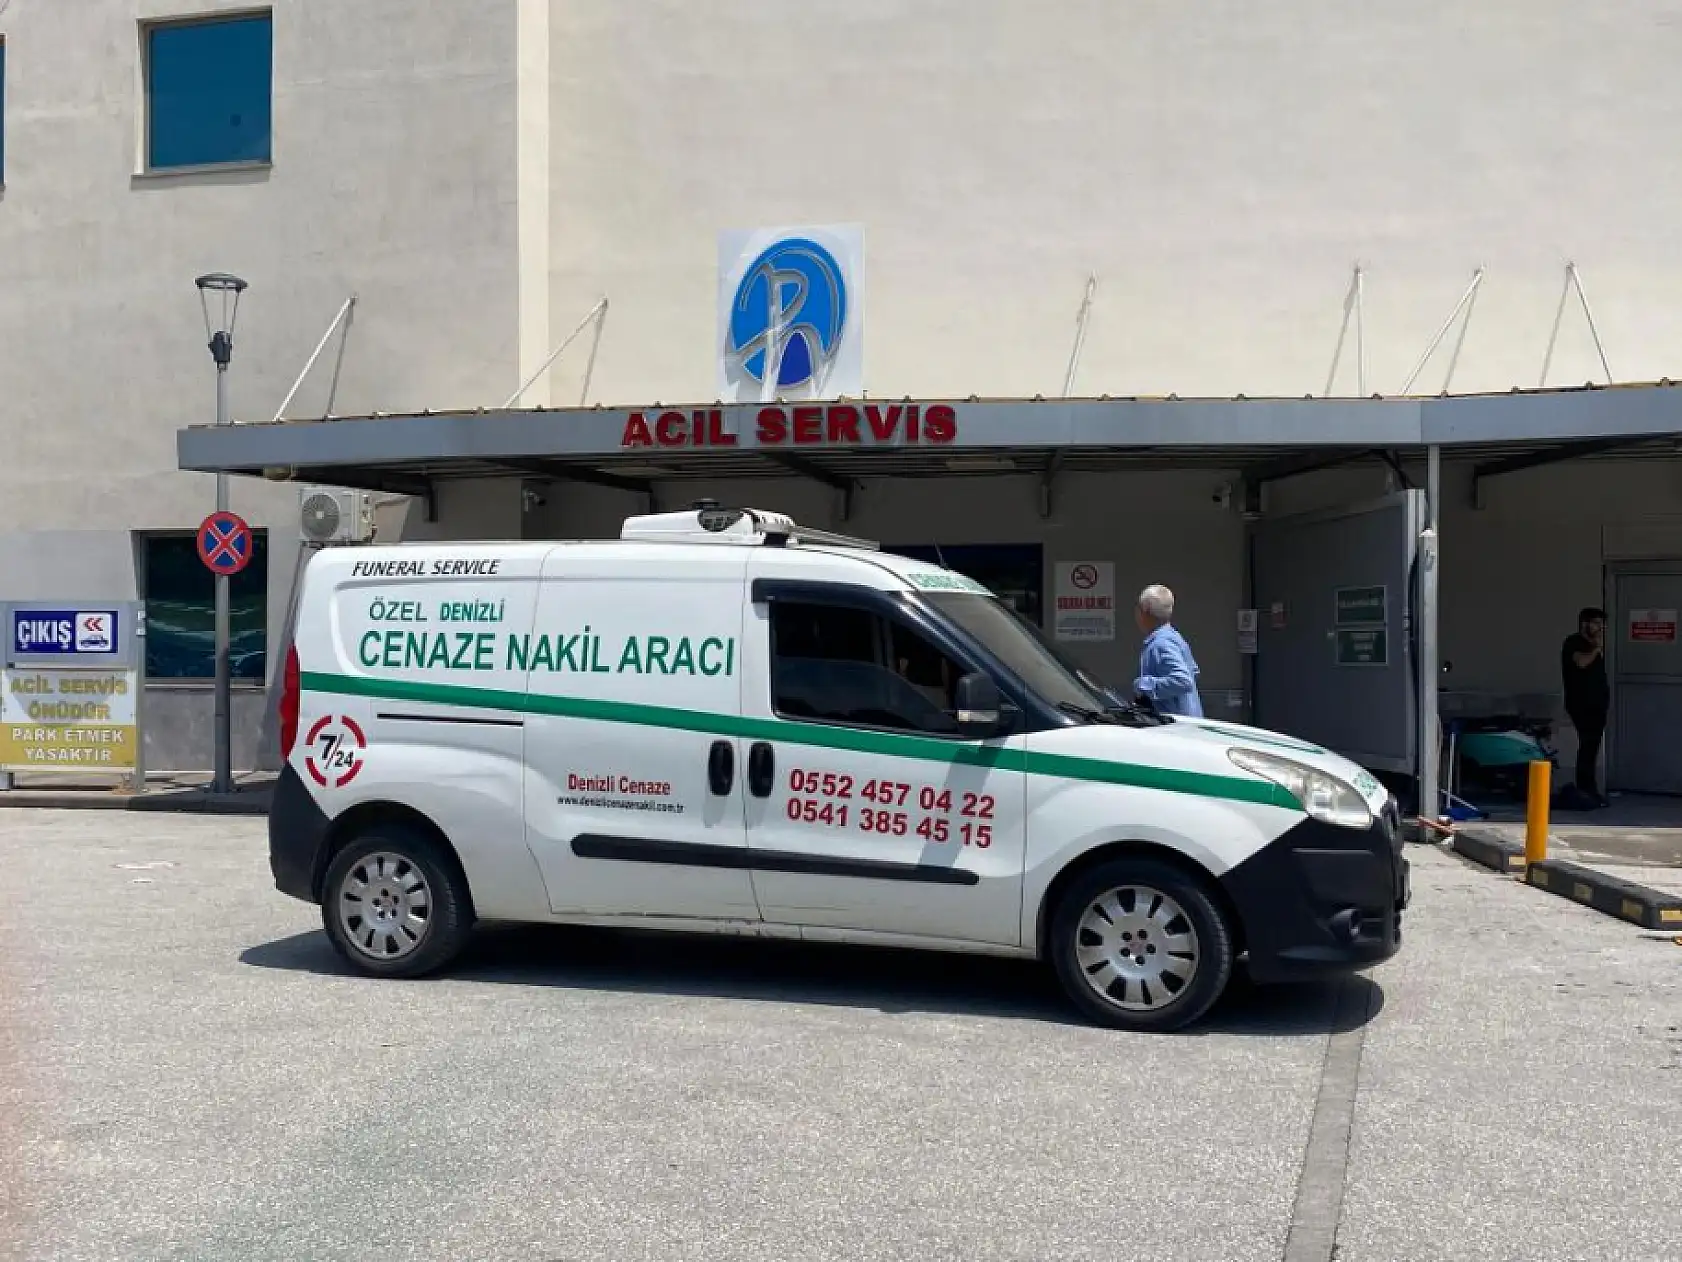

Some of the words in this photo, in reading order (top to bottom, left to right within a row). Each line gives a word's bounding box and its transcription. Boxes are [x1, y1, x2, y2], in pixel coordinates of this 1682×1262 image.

[351, 560, 426, 577] FUNERAL
[430, 558, 500, 575] SERVICE
[369, 595, 428, 621] ÖZEL
[439, 597, 505, 622] DENİZLİ
[17, 619, 73, 650] ÇIKIŞ
[360, 630, 496, 670] CENAZE
[505, 624, 610, 672] NAKİL
[616, 635, 735, 677] ARACI
[12, 727, 57, 743] PARK
[65, 728, 124, 744] ETMEK
[23, 747, 112, 762] YASAKTIR
[567, 773, 616, 793] Denizli
[619, 775, 671, 796] Cenaze
[789, 768, 854, 798] 0552
[860, 779, 911, 806] 457
[919, 786, 952, 813] 04
[960, 792, 995, 819] 22
[787, 797, 849, 828] 0541
[859, 808, 908, 835] 385
[916, 816, 949, 842] 45
[960, 822, 992, 848] 15
